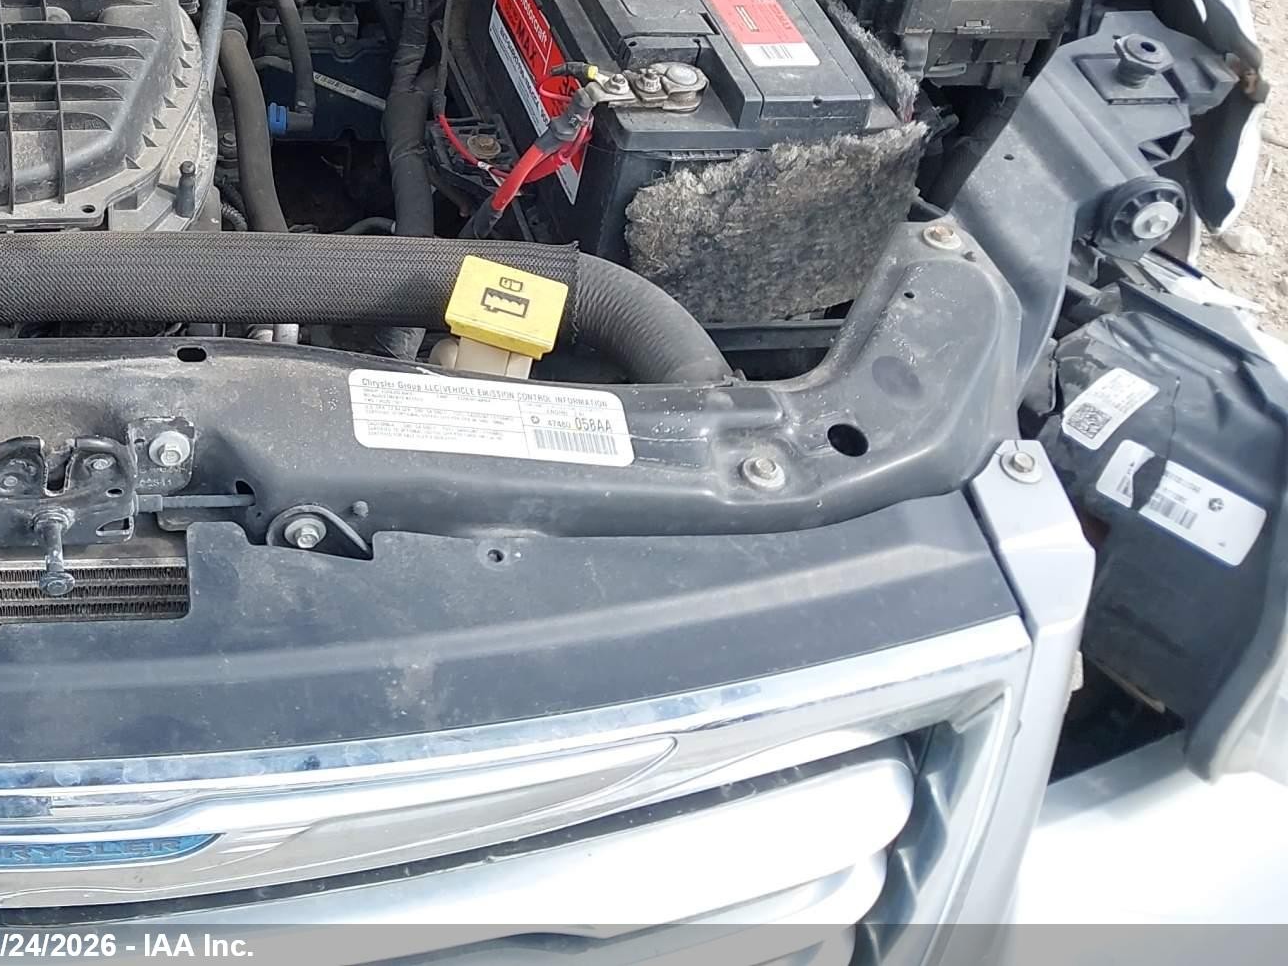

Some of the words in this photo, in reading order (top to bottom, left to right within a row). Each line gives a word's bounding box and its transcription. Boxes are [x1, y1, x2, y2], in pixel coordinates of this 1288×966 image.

[361, 378, 396, 390] Chrysler
[397, 381, 422, 393] Group
[423, 383, 440, 393] LLC
[442, 384, 475, 396] VEHICLE
[477, 388, 515, 400] EMISSION
[517, 392, 552, 404] CONTROL
[555, 396, 608, 408] INFORMATION
[574, 416, 612, 432] 058AA
